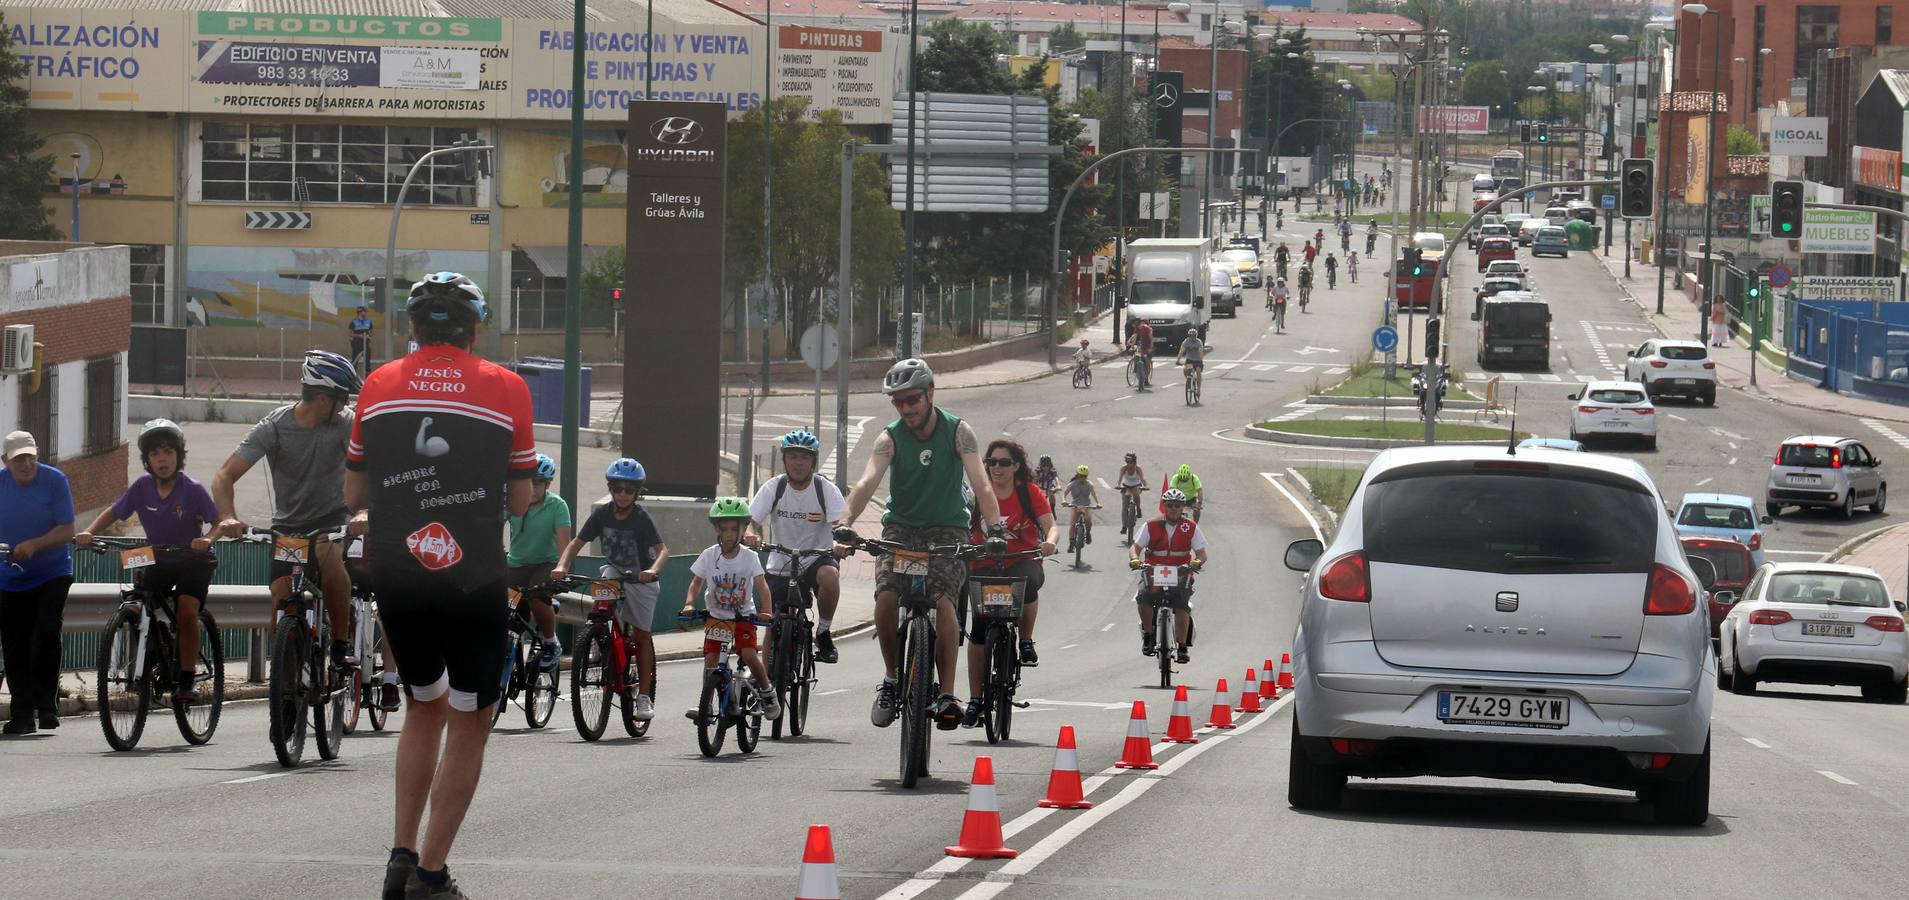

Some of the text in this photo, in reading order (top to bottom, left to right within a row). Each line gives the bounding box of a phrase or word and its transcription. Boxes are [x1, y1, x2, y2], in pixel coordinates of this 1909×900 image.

[227, 16, 470, 36] PRODUCTOS
[9, 20, 159, 48] ALIZACIÓN
[800, 32, 863, 48] PINTURAS
[673, 34, 685, 53] Y
[690, 34, 749, 54] VENTA
[231, 46, 378, 64] EDIFICIO EN VENTA
[19, 51, 140, 78] TRÁFICO
[605, 61, 697, 81] PINTURAS
[703, 63, 716, 82] Y
[257, 66, 285, 79] 983
[288, 67, 306, 80] 33
[331, 68, 349, 81] 33
[223, 95, 301, 108] PROTECTORES
[304, 97, 320, 108] DE
[378, 98, 409, 109] PARA
[413, 99, 485, 111] MOTORISTAS
[638, 148, 715, 162] HYUNDAI
[650, 192, 701, 206] Talleres y
[645, 205, 705, 218] Grúas Ávila
[1805, 227, 1870, 241] MUEBLES
[415, 366, 463, 379] JESÚS
[408, 380, 466, 393] NEGRO
[383, 465, 437, 488] SIEMPRE
[414, 479, 441, 493] CON
[420, 487, 486, 510] NOSOTROS
[986, 593, 1012, 602] 1697
[1464, 624, 1547, 636] ALTEA
[1808, 624, 1831, 634] 3187
[1454, 695, 1511, 718] 7429
[1520, 699, 1562, 721] GYW
